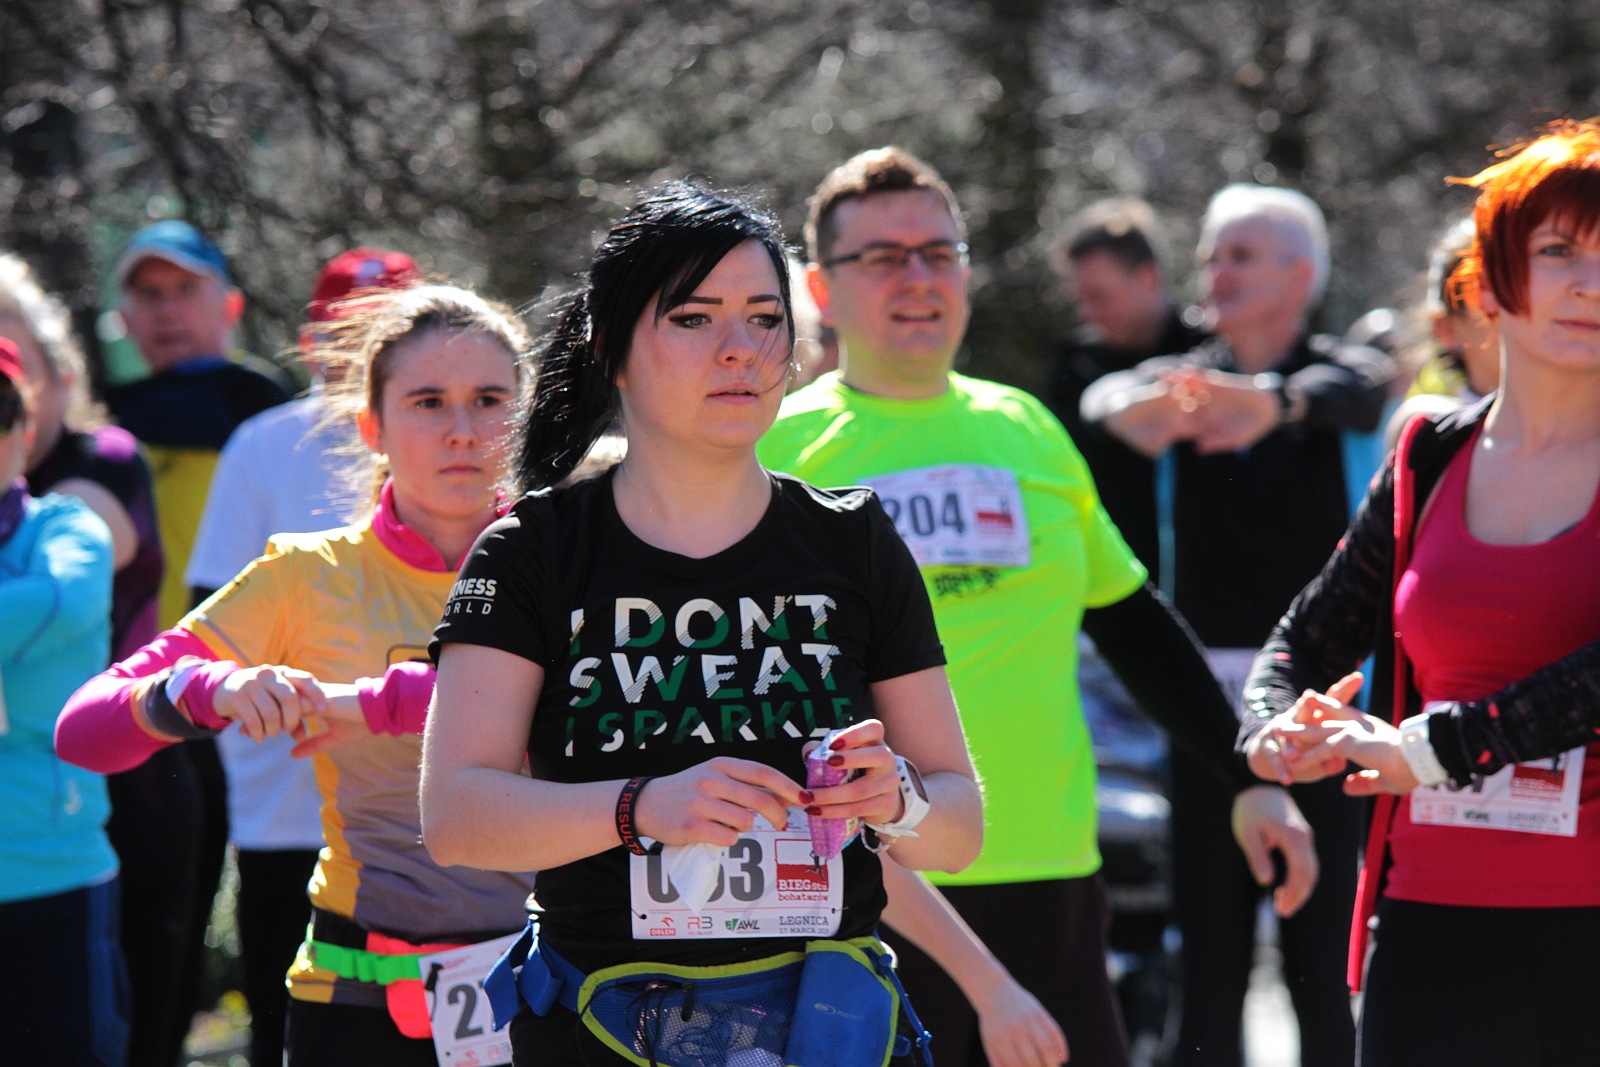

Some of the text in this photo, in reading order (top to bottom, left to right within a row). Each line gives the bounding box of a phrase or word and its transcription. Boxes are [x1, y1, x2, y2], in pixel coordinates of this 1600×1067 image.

[569, 608, 584, 655] I
[569, 643, 842, 708] SWEAT
[565, 697, 852, 757] I SPARKLE
[619, 792, 645, 855] RESULTS
[647, 838, 764, 904] 03
[778, 879, 810, 891] BIEG
[651, 928, 676, 936] ORLEN
[779, 915, 829, 926] LEGNICA
